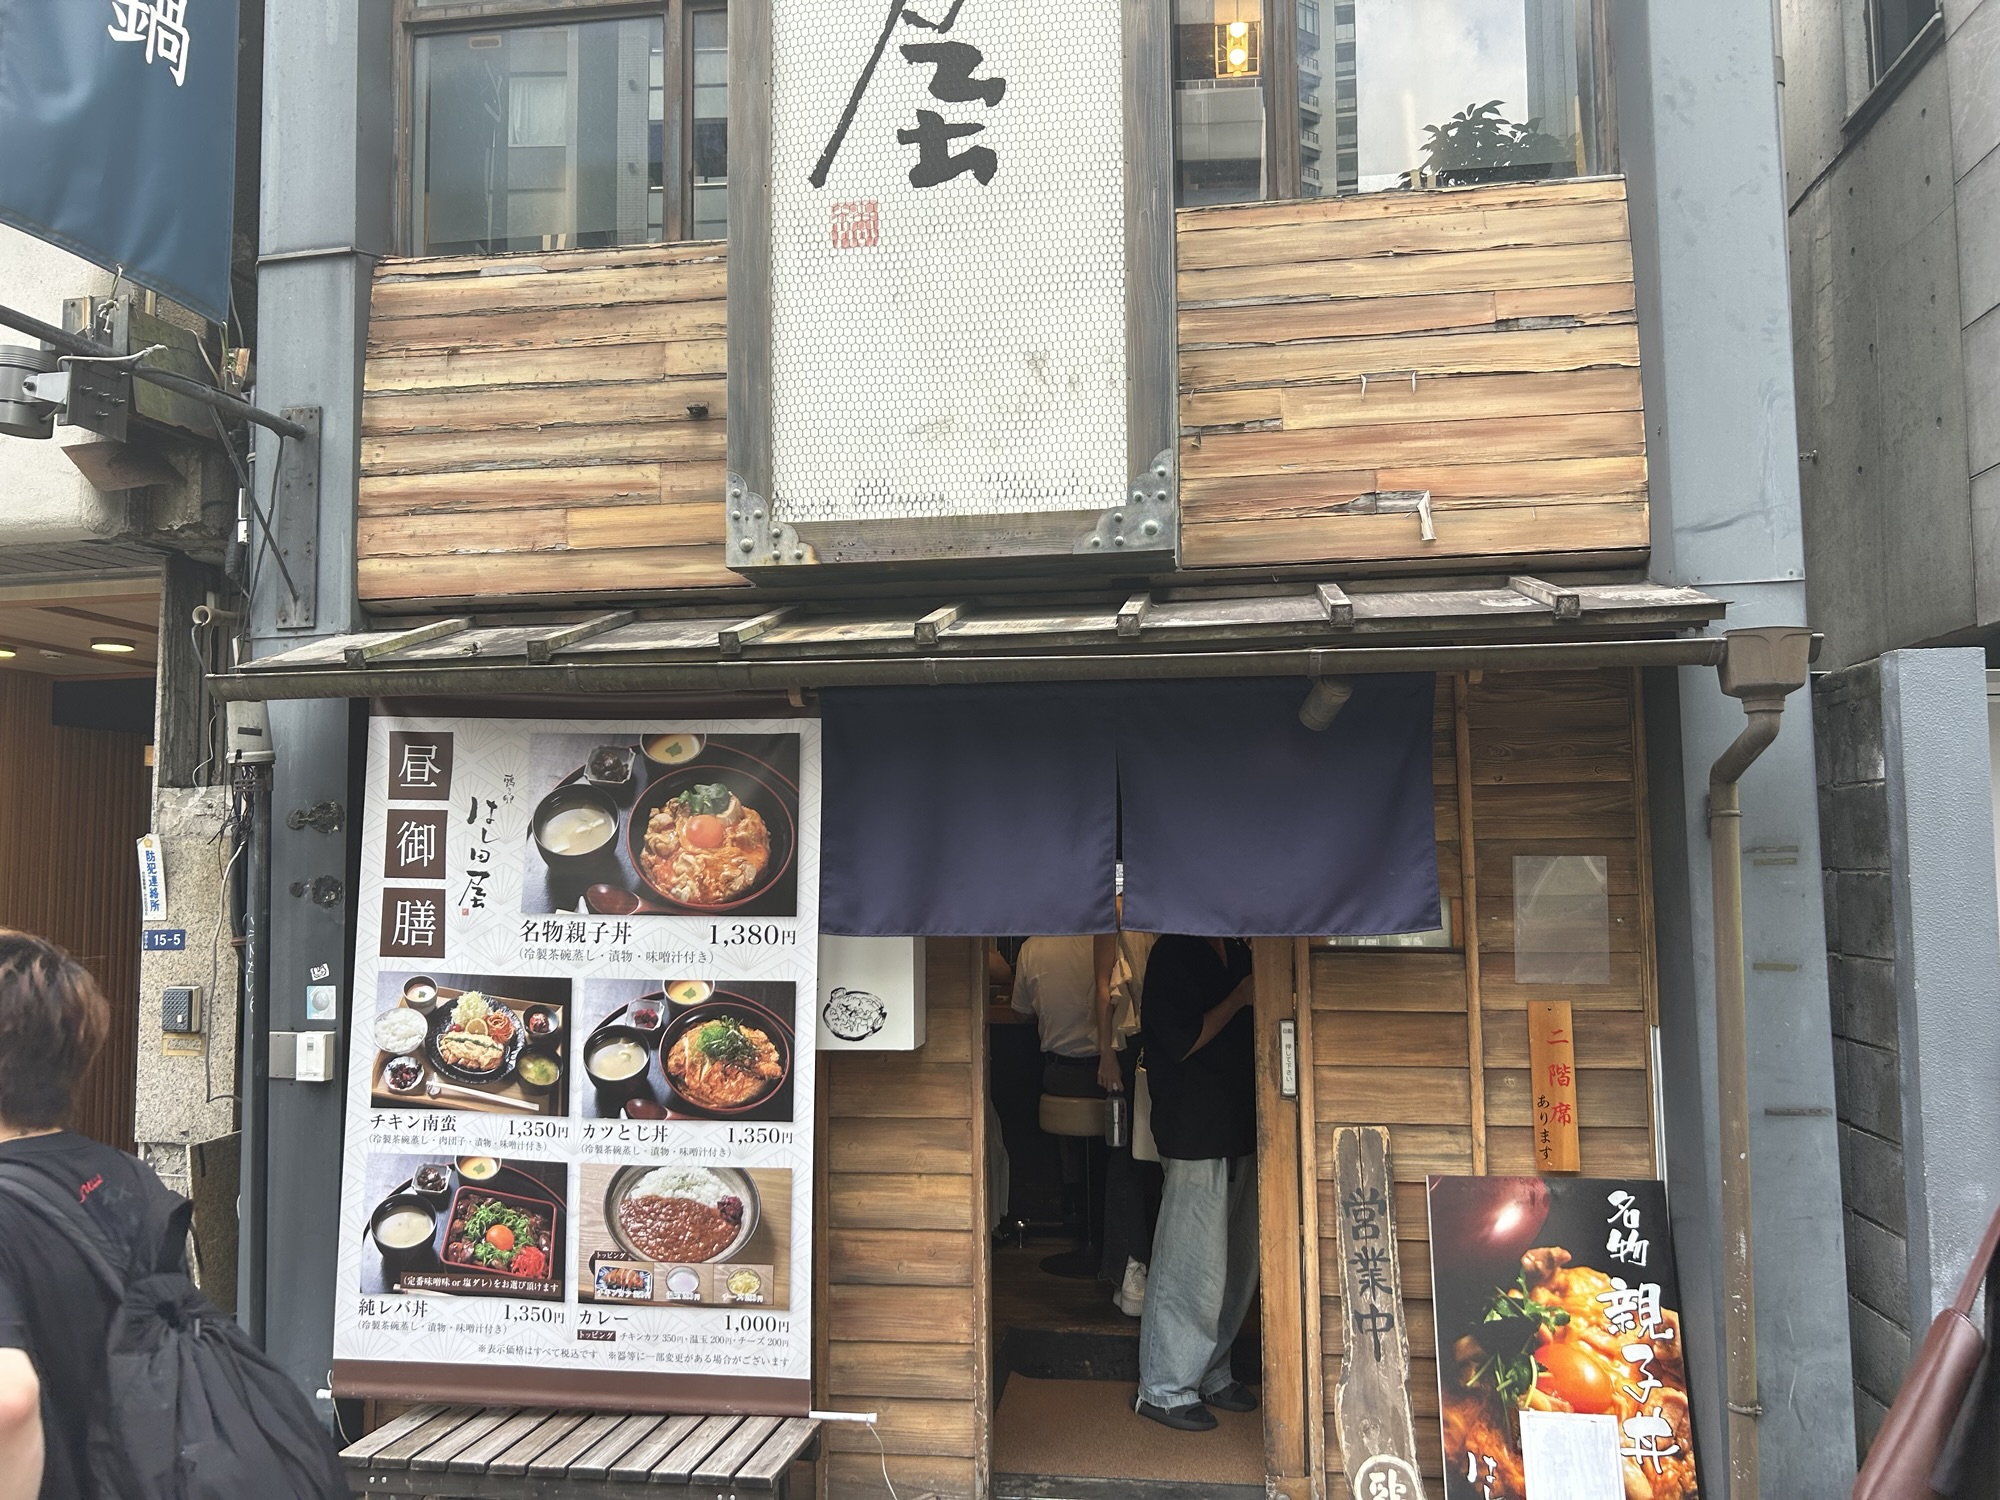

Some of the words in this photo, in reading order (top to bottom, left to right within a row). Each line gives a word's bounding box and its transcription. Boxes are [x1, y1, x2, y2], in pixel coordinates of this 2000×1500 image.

[392, 744, 441, 946] 昼御膳
[145, 850, 160, 912] 防犯連絡所
[154, 934, 181, 946] 15-5
[519, 919, 633, 945] 名物親子丼
[709, 923, 797, 947] 1,380円
[1547, 1028, 1572, 1127] 二階席
[370, 1114, 457, 1133] チキン南蛮
[508, 1119, 569, 1139] 1,350円
[583, 1124, 669, 1143] カツとじ丼
[1536, 1094, 1552, 1161] あります
[728, 1127, 793, 1145] 1,350円
[451, 1279, 460, 1287] or
[1343, 1188, 1394, 1363] 営業中
[358, 1298, 428, 1318] 純レバ丼
[503, 1304, 565, 1325] 1,350円
[579, 1309, 629, 1326] カレー
[724, 1314, 790, 1333] 1,000円
[578, 1330, 614, 1340] トッピング
[619, 1333, 659, 1342] チキンカツ
